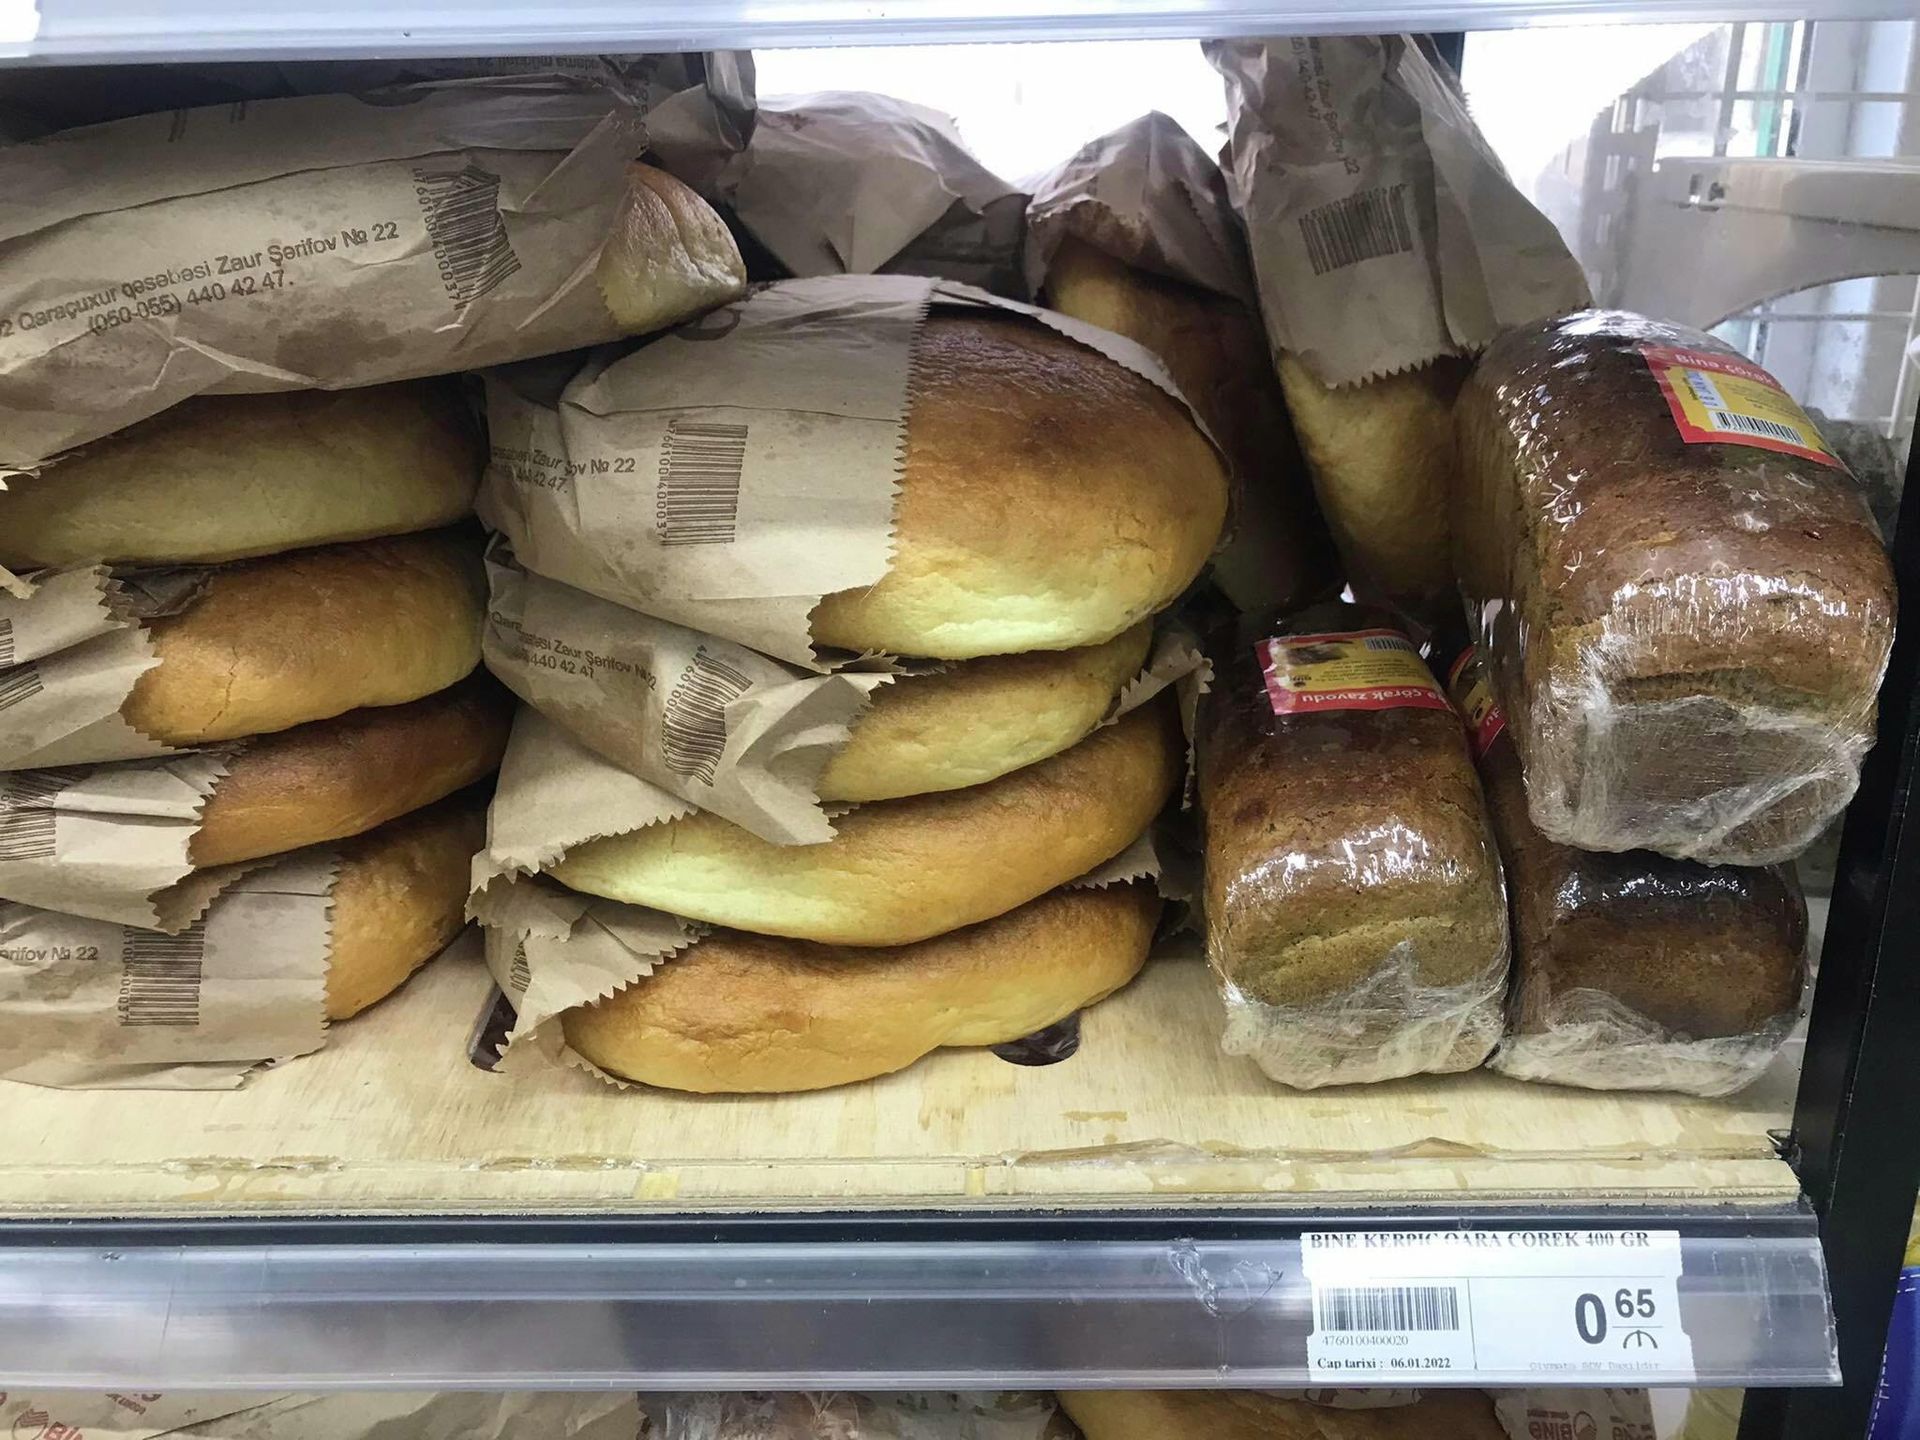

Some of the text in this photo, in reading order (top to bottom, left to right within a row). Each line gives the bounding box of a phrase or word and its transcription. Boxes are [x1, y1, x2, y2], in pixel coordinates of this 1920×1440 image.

[0, 319, 15, 337] 2
[18, 285, 117, 331] Qaraçuxur
[121, 261, 211, 300] qəsəbəsi
[215, 251, 262, 275] Zaur
[267, 236, 336, 267] Şərifov
[371, 221, 399, 242] 22
[88, 293, 182, 337] (050-055)
[187, 281, 226, 306] 440
[231, 275, 257, 297] 42
[613, 457, 636, 473] 22
[554, 640, 582, 659] Zaur
[560, 659, 576, 675] 42
[75, 946, 98, 961] 22
[1311, 1233, 1357, 1248] BINE
[1508, 1231, 1580, 1248] COREK
[1585, 1231, 1614, 1248] 400
[1620, 1231, 1650, 1248] GR
[1575, 1288, 1656, 1345] 0 65
[1321, 1335, 1409, 1347] 4760100400020
[1317, 1358, 1342, 1370] Cap
[1345, 1357, 1376, 1369] tarixi
[1390, 1357, 1451, 1369] 06.01.2022
